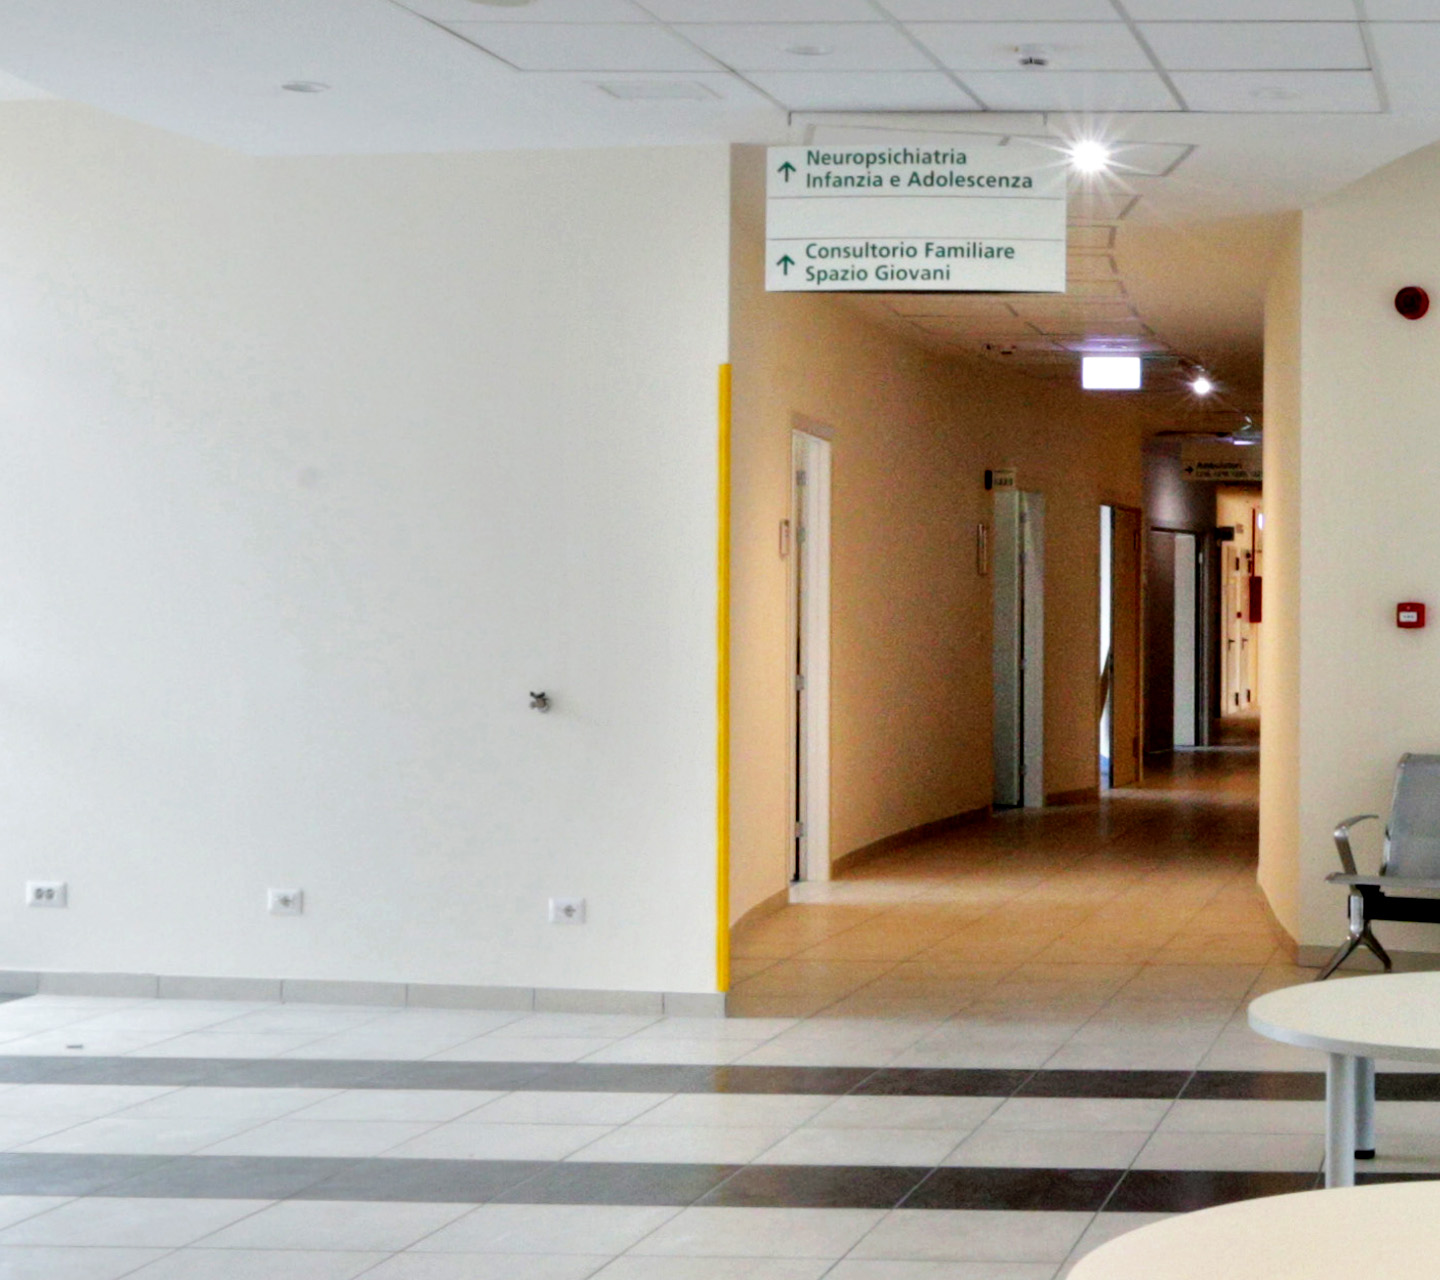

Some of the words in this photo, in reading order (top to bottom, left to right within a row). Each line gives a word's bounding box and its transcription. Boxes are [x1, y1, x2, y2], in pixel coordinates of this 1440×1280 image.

[806, 148, 967, 167] Neuropsichiatria
[806, 171, 883, 188] Infanzia
[890, 175, 901, 188] e
[907, 171, 1033, 189] Adolescenza
[805, 242, 918, 259] Consultorio
[924, 242, 1016, 259] Familiare
[805, 266, 868, 284] Spazio
[875, 265, 951, 281] Giovani
